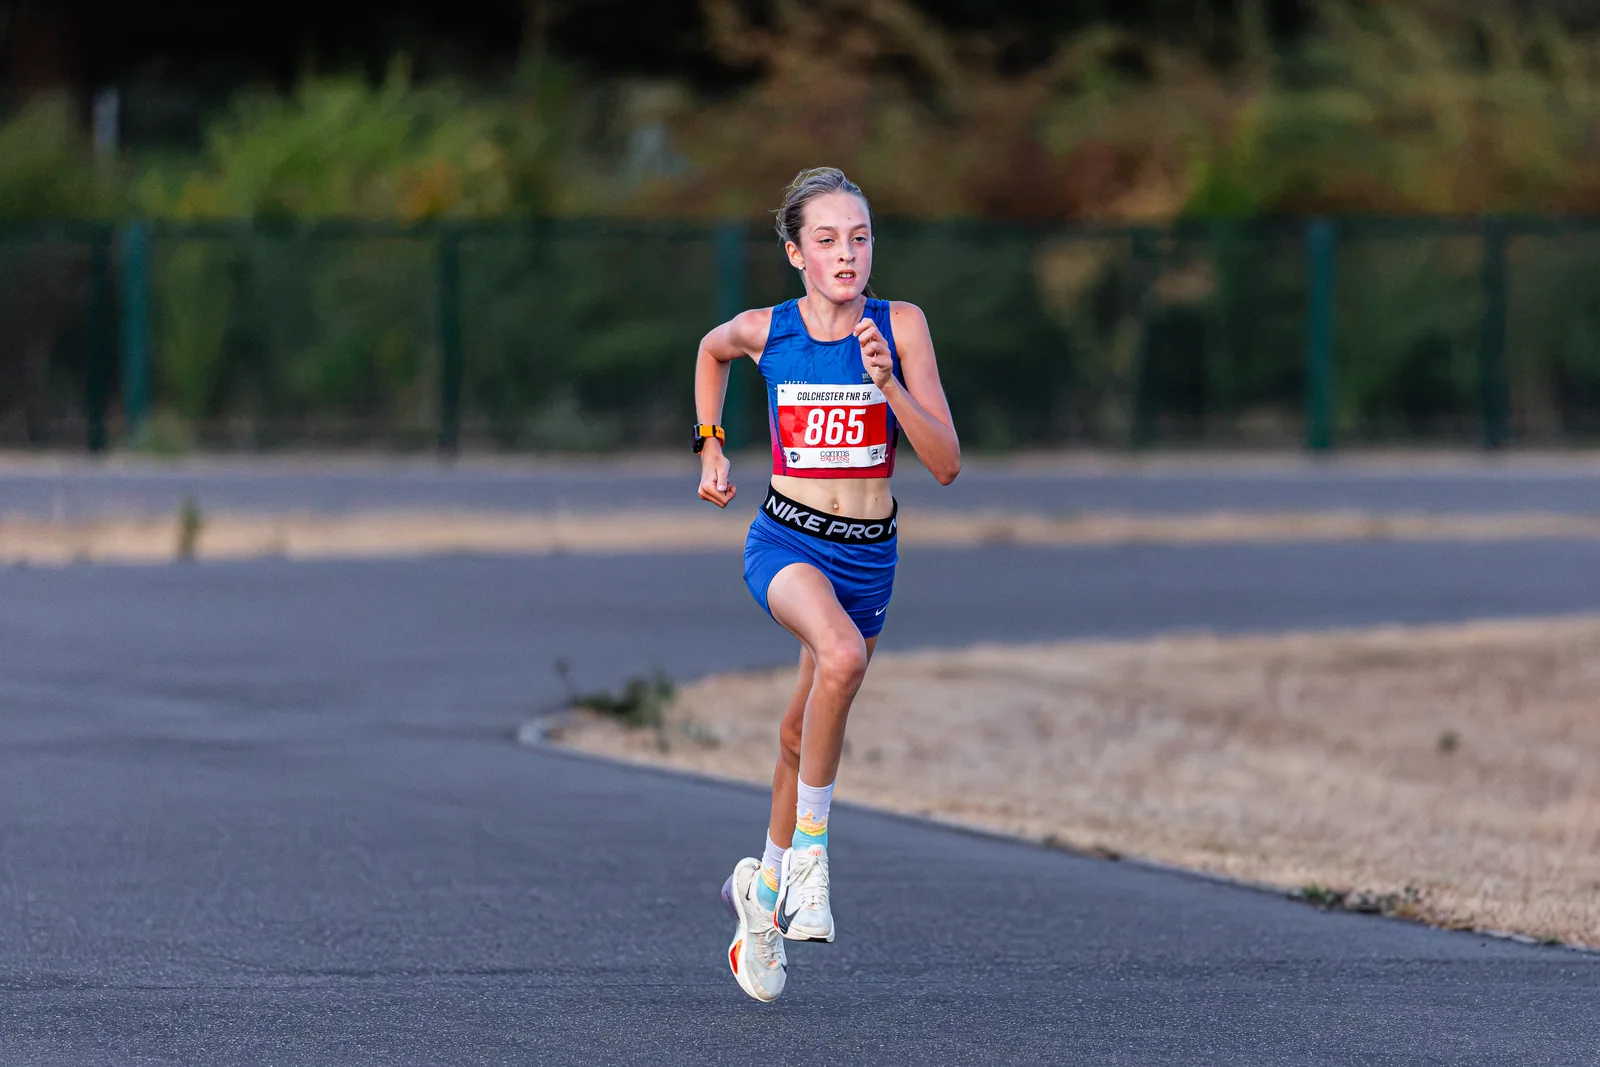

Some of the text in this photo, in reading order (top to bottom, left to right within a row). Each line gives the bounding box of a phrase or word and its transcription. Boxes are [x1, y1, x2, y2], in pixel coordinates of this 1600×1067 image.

[797, 391, 872, 401] COLCHESTER FNR 5K
[804, 408, 866, 446] 865
[766, 495, 826, 533] NIKE
[825, 520, 884, 540] PRO
